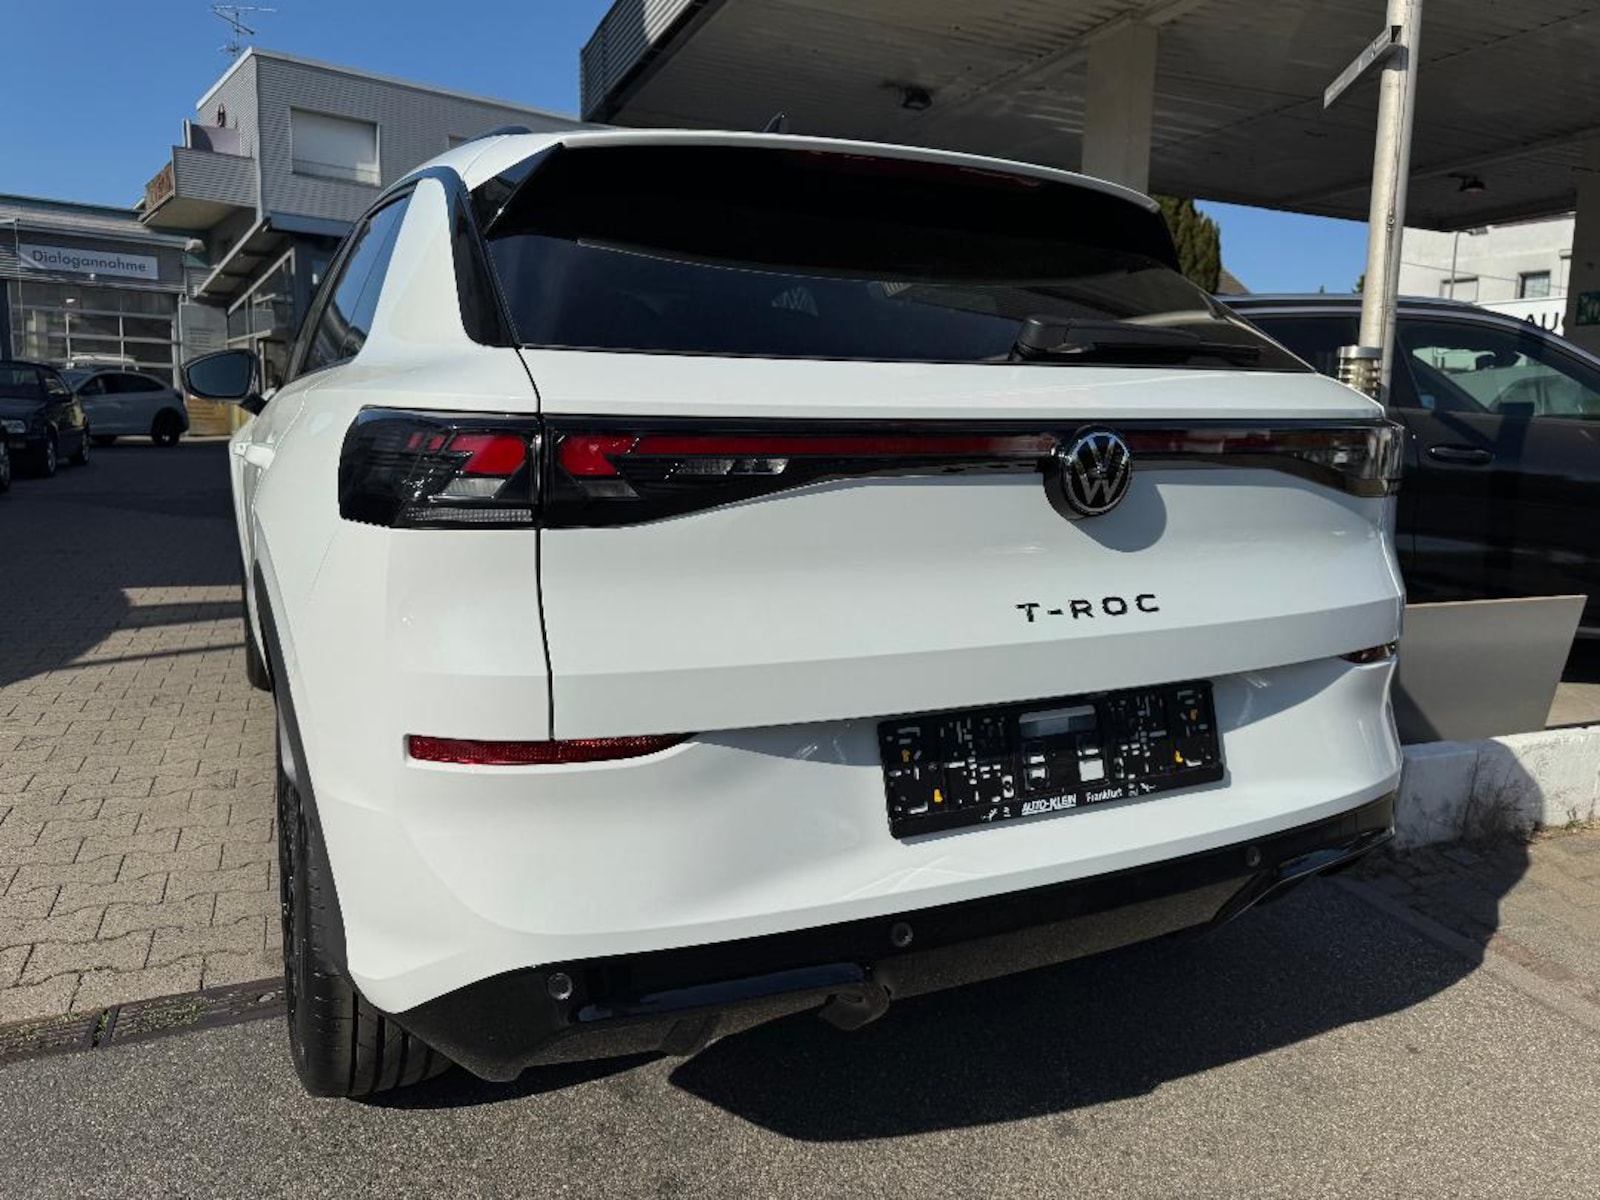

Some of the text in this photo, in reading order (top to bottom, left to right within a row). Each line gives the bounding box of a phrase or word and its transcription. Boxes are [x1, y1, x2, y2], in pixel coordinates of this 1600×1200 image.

[32, 250, 146, 272] Dialogannahme
[1523, 311, 1565, 332] AU
[1015, 594, 1160, 622] T-ROC
[1021, 787, 1123, 815] AUTO-KLEIN Frankfurt
